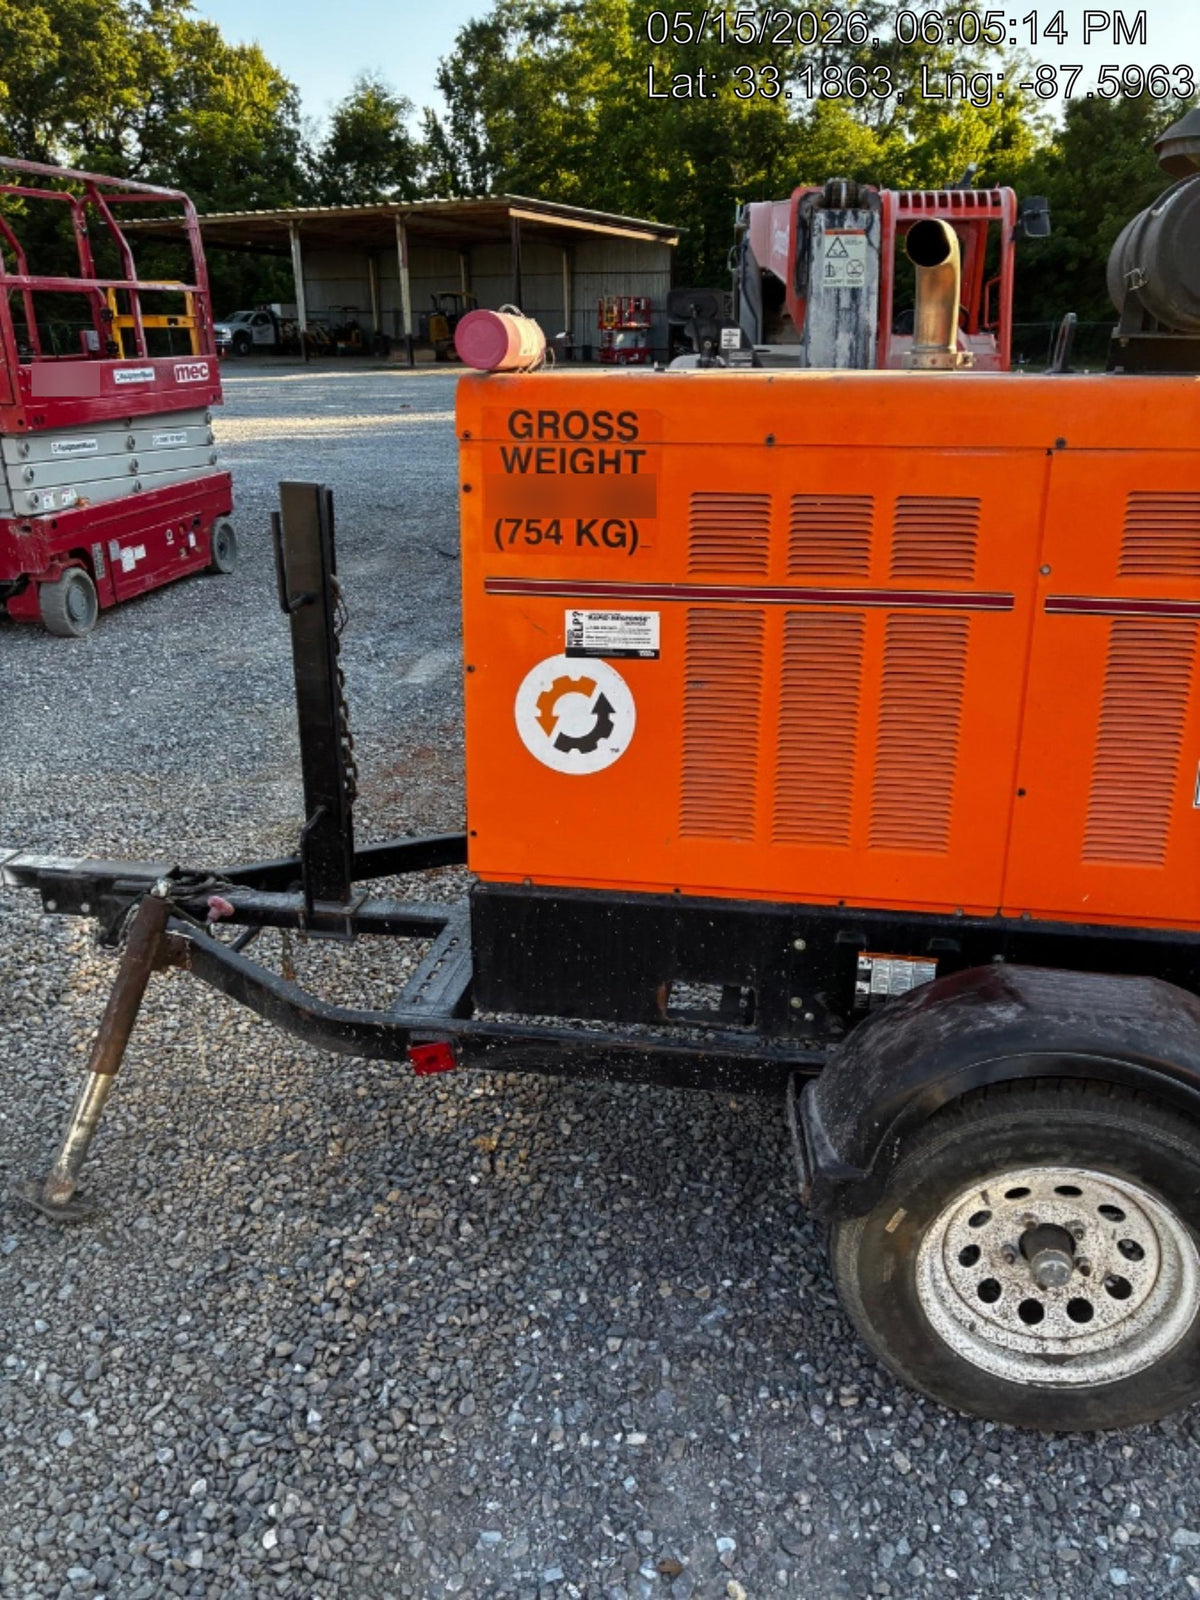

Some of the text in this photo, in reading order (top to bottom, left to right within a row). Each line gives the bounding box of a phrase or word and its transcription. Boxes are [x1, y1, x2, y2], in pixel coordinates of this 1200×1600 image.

[508, 409, 639, 442] GROSS
[500, 446, 647, 474] WEIGHT
[494, 518, 639, 556] (754 KG)
[572, 611, 583, 646] HELP?
